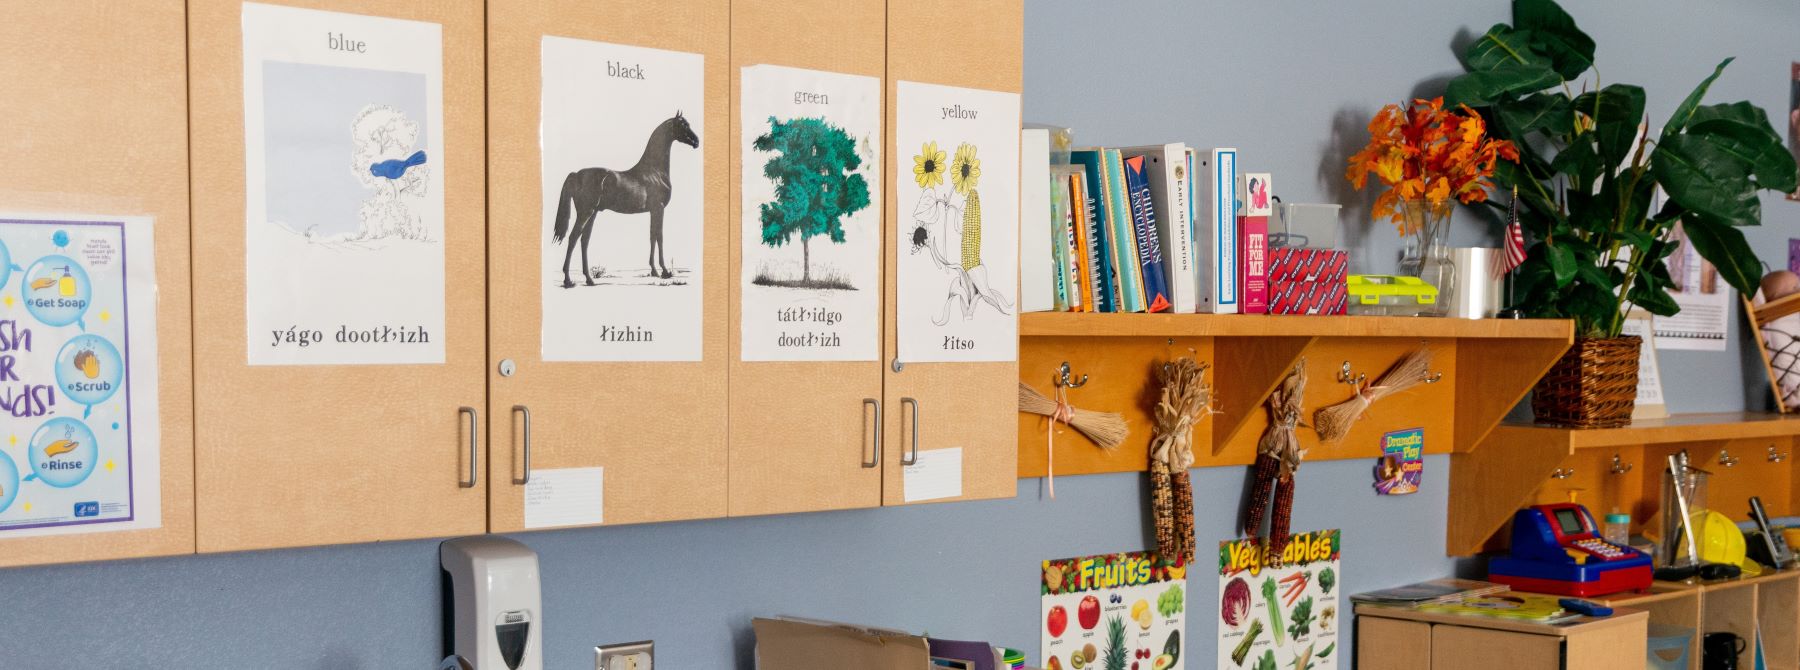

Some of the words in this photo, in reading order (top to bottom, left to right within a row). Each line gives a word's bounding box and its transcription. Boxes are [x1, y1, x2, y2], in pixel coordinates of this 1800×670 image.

[328, 31, 367, 54] blue
[607, 60, 645, 80] black
[794, 91, 829, 105] green
[942, 104, 978, 120] yellow
[1132, 192, 1152, 267] ENCYCLOPEDIA
[1179, 211, 1188, 271] INTERVENTION
[1249, 233, 1264, 249] FIT
[1249, 249, 1264, 261] FOR
[1249, 261, 1264, 276] ME
[35, 299, 55, 308] Get
[57, 298, 87, 310] Soap
[271, 325, 323, 347] yágo
[600, 325, 653, 342] łizhin
[942, 335, 975, 350] łitso
[75, 381, 111, 392] Scrub
[1387, 432, 1422, 448] Dramatic
[1403, 446, 1420, 460] Play
[49, 459, 83, 470] Rinse
[1402, 462, 1422, 472] Center
[1228, 533, 1332, 576] Vegeables
[1079, 558, 1152, 591] Fruits
